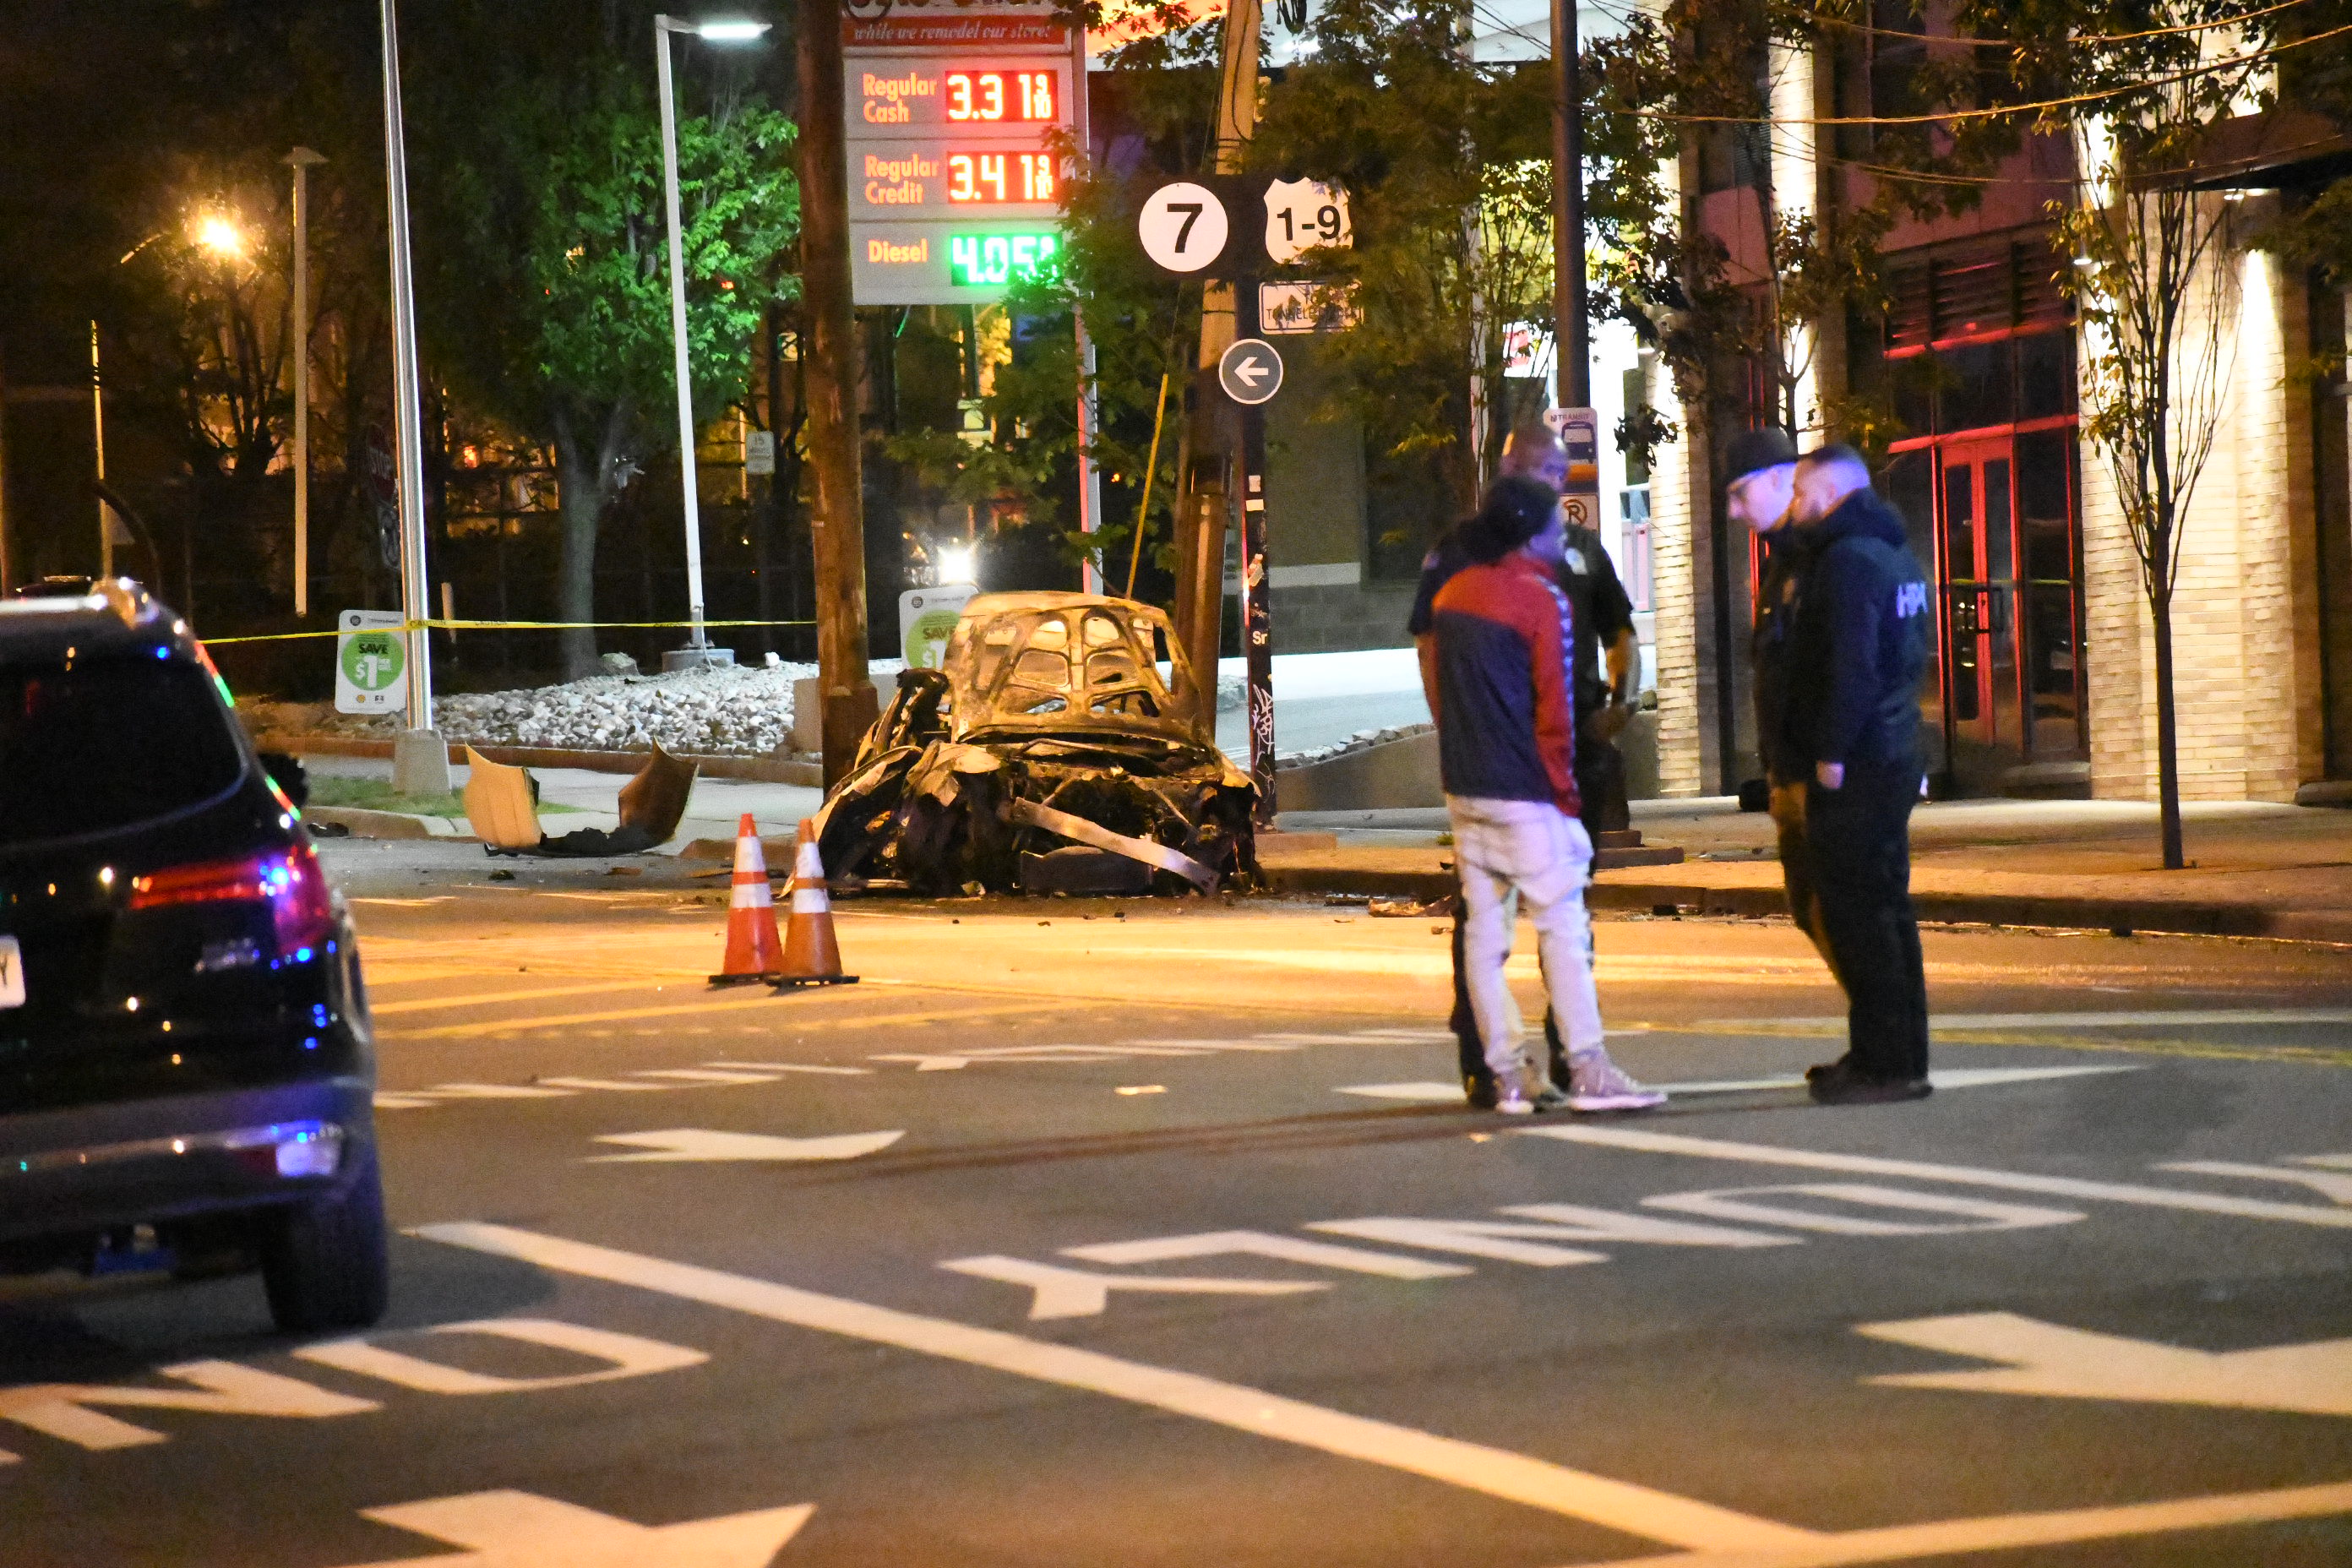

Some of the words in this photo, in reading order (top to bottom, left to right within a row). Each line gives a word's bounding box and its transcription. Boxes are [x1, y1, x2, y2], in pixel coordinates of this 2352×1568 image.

[854, 24, 894, 40] while
[898, 28, 917, 39] we
[921, 21, 981, 39] remodel
[983, 27, 1007, 38] our
[863, 73, 937, 100] Regular
[863, 100, 910, 122] Cash
[865, 154, 939, 182] Regular
[865, 181, 924, 204] Credit
[1167, 203, 1203, 253] 7
[1277, 204, 1342, 242] 1-9
[868, 238, 928, 263] Diesel
[358, 643, 389, 654] SAVE
